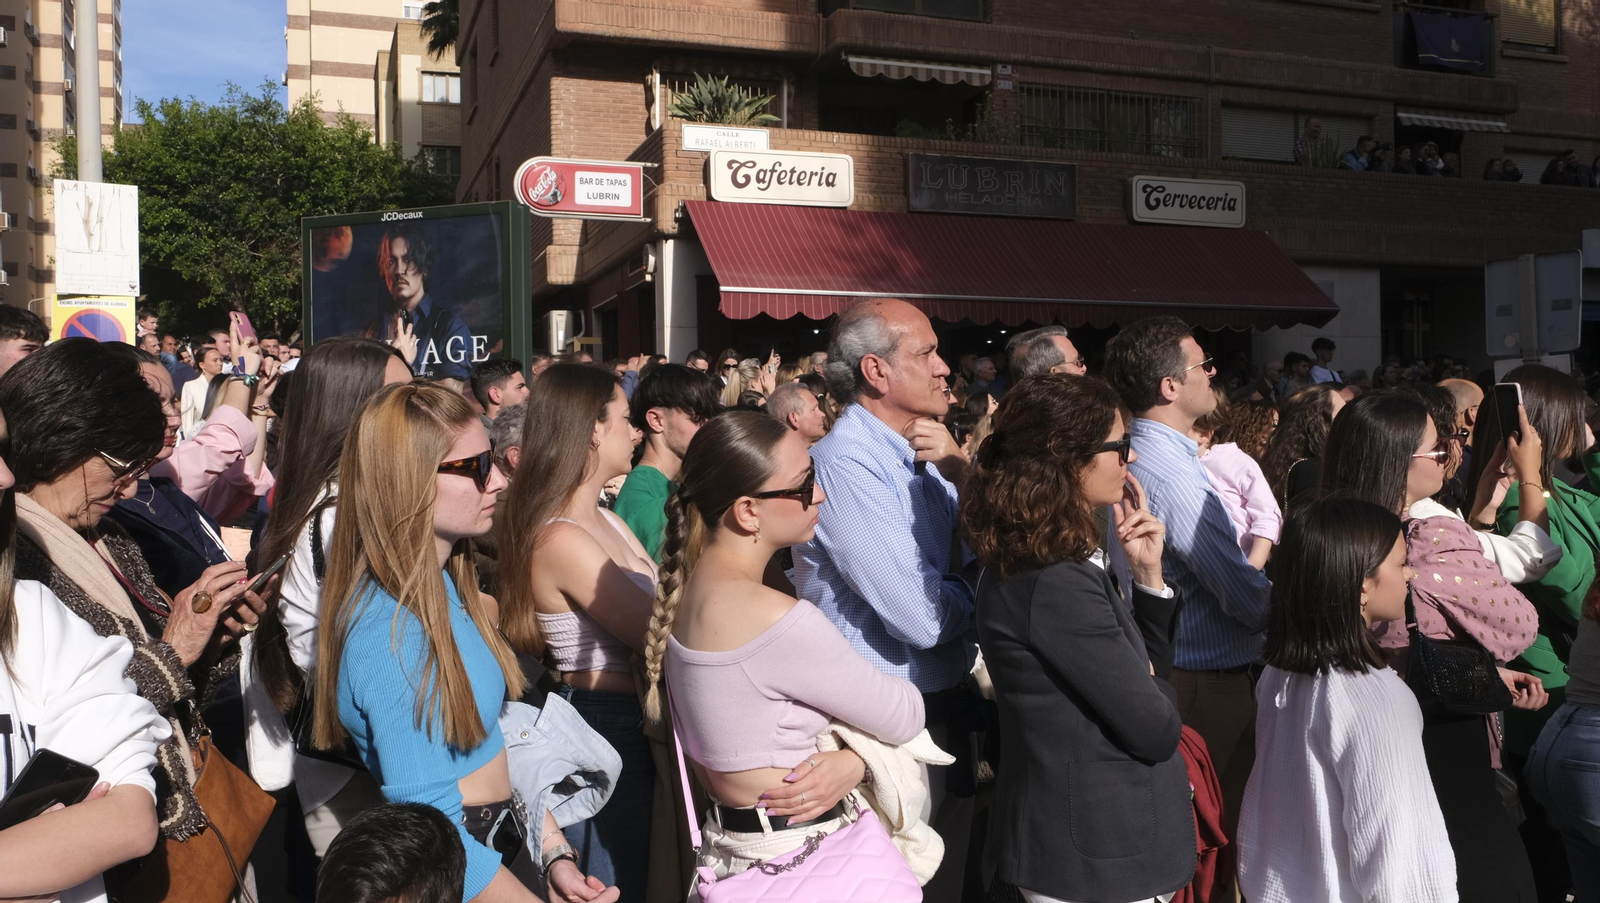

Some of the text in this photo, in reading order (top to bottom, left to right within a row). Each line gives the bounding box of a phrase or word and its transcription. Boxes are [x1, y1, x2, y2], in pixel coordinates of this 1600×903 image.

[695, 138, 756, 149] RAFAEL ALBERTI
[579, 177, 627, 187] BAR DE TAPAS
[726, 159, 837, 191] Cafeteria
[920, 162, 1067, 196] LUBRIN
[587, 192, 620, 200] LUBRIN
[946, 191, 1044, 208] HELADERIA
[1142, 184, 1238, 212] Cerveceria
[381, 211, 423, 221] JCDecaux
